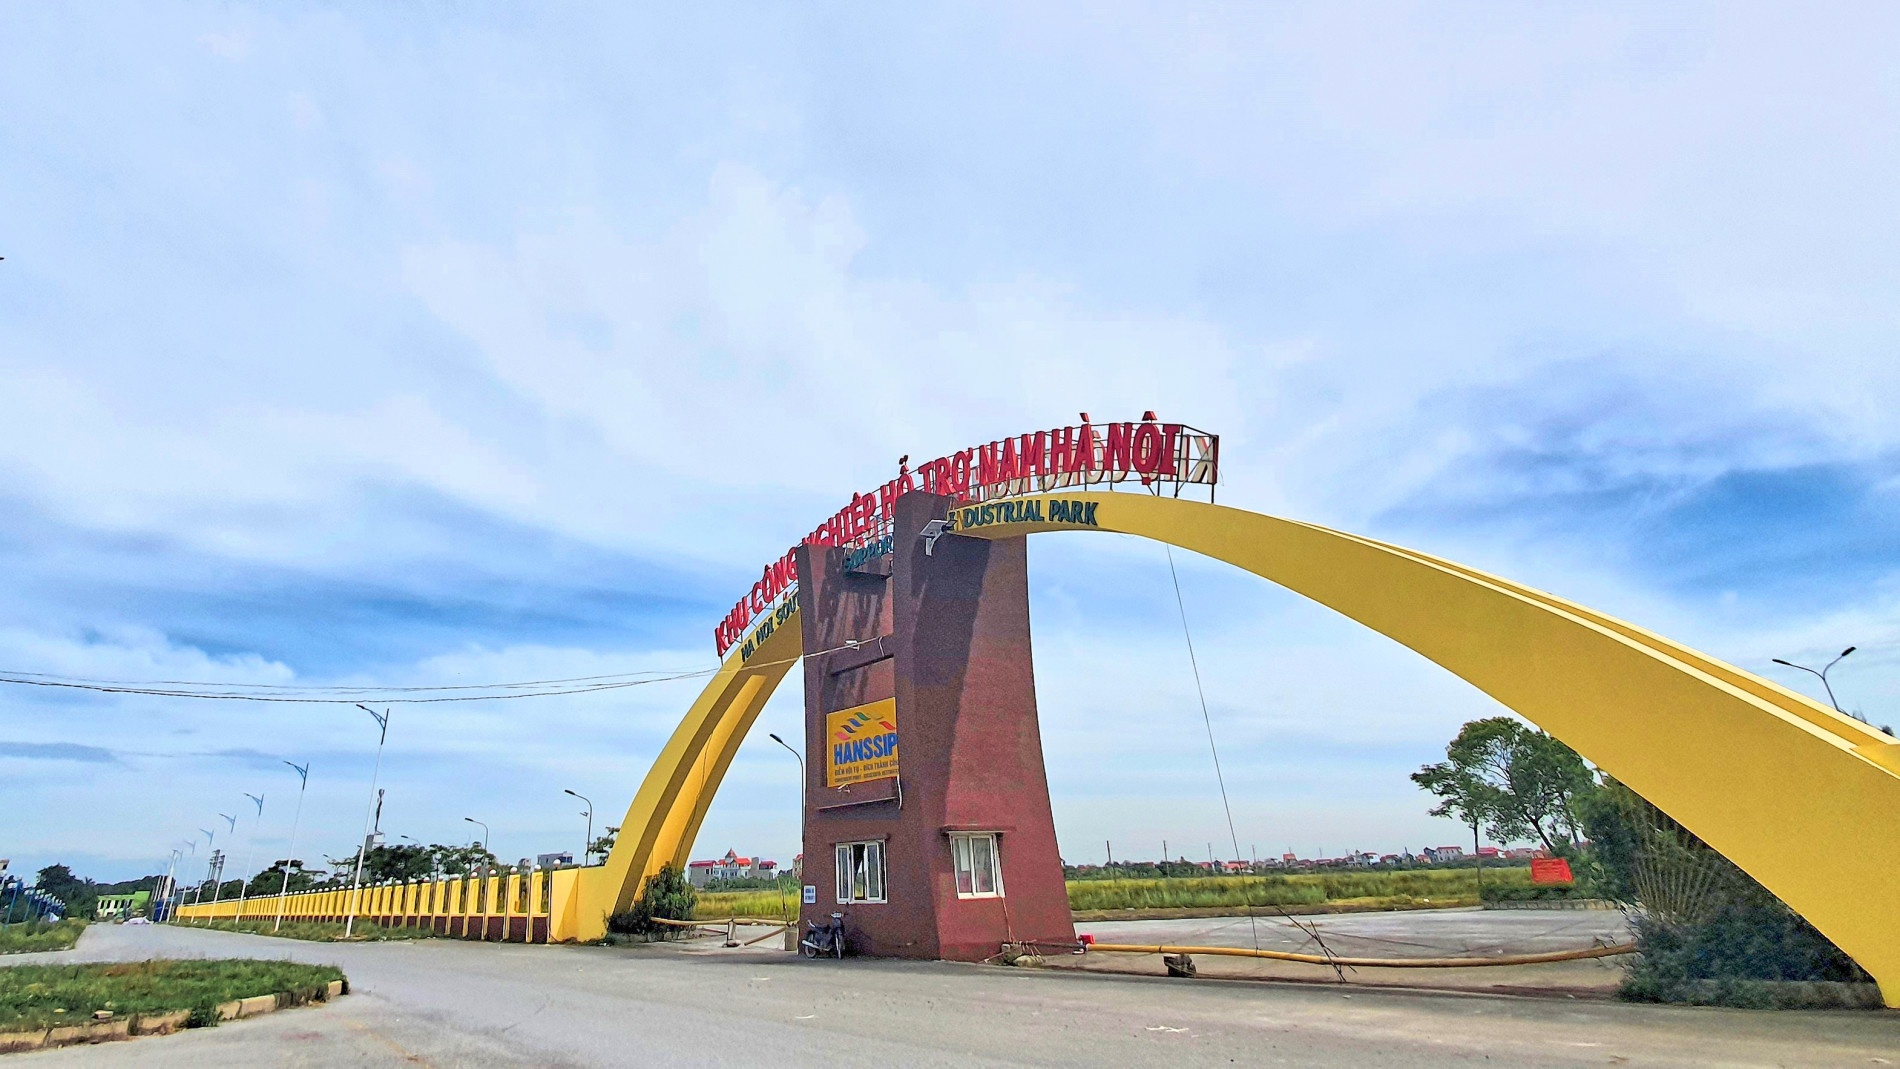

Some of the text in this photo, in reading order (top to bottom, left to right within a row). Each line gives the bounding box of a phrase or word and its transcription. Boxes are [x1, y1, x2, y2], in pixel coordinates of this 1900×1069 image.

[715, 596, 750, 657] KHU
[751, 547, 798, 614] CÔNG
[979, 431, 1046, 486] NAM
[1051, 413, 1096, 474] HÀ
[1103, 411, 1181, 485] NỘI
[741, 639, 755, 662] HA
[756, 616, 774, 646] NOI
[844, 535, 894, 571] SUPPOR
[1049, 500, 1099, 526] PARK
[834, 732, 898, 765] HANSSIP
